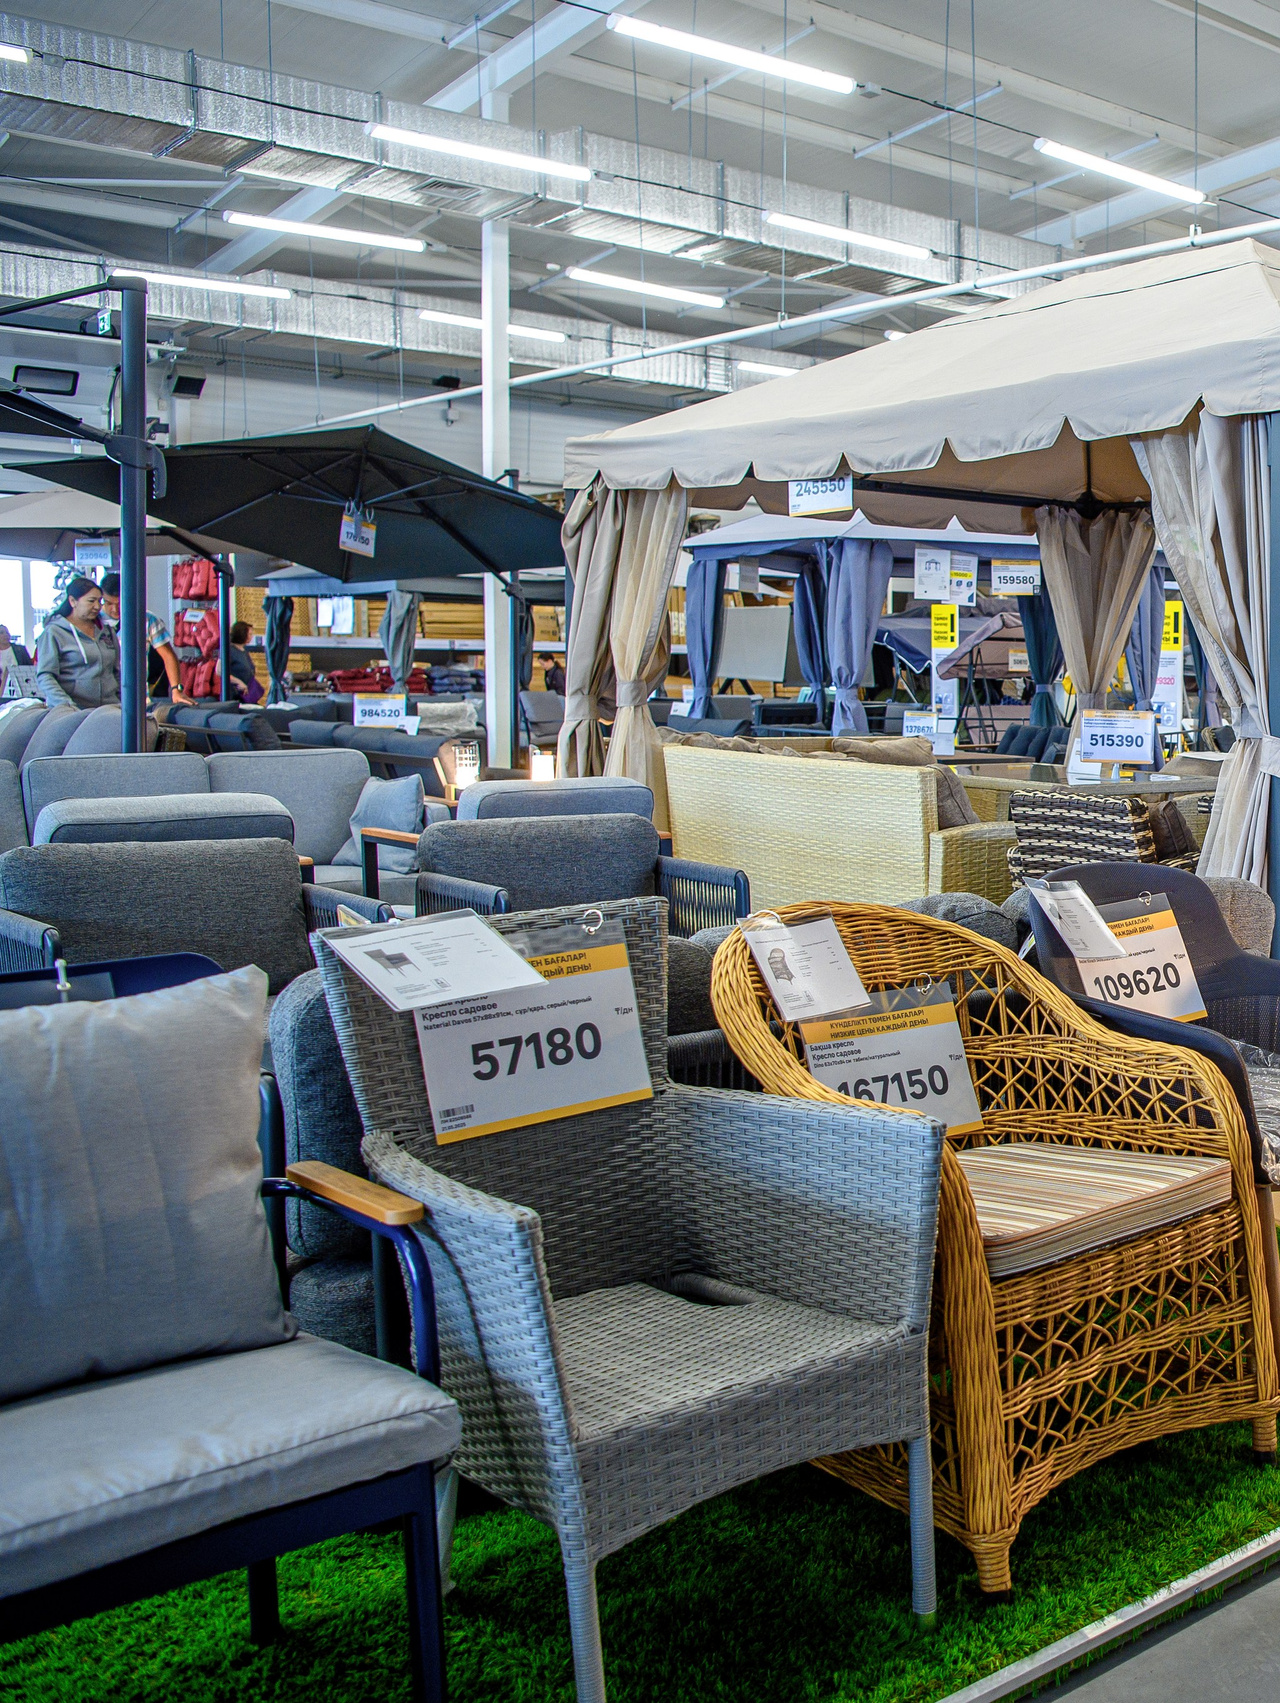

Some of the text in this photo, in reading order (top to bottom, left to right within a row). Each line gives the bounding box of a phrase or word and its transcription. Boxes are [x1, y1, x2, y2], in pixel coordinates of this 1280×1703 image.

[796, 476, 846, 497] 245550
[997, 575, 1035, 585] 159580
[361, 709, 401, 717] 984520
[1089, 733, 1144, 748] 515390
[544, 952, 588, 967] БАҒАЛАР!
[566, 963, 593, 975] ДЕНЬ!
[1093, 962, 1181, 1002] 109620
[421, 1008, 458, 1022] Кресло
[458, 1002, 498, 1018] садовое
[868, 1015, 892, 1024] ТӨМЕН
[891, 1009, 925, 1020] БАҒАЛАР!
[452, 1017, 472, 1027] Davos
[830, 1018, 929, 1039] НИЗКИЕ ЦЕНЫ КАЖДЫЙ ДЕНЬ!
[471, 1022, 602, 1081] 57180
[832, 1040, 855, 1050] кресло
[812, 1048, 862, 1061] Кресло садовое
[837, 1064, 950, 1104] 167150
